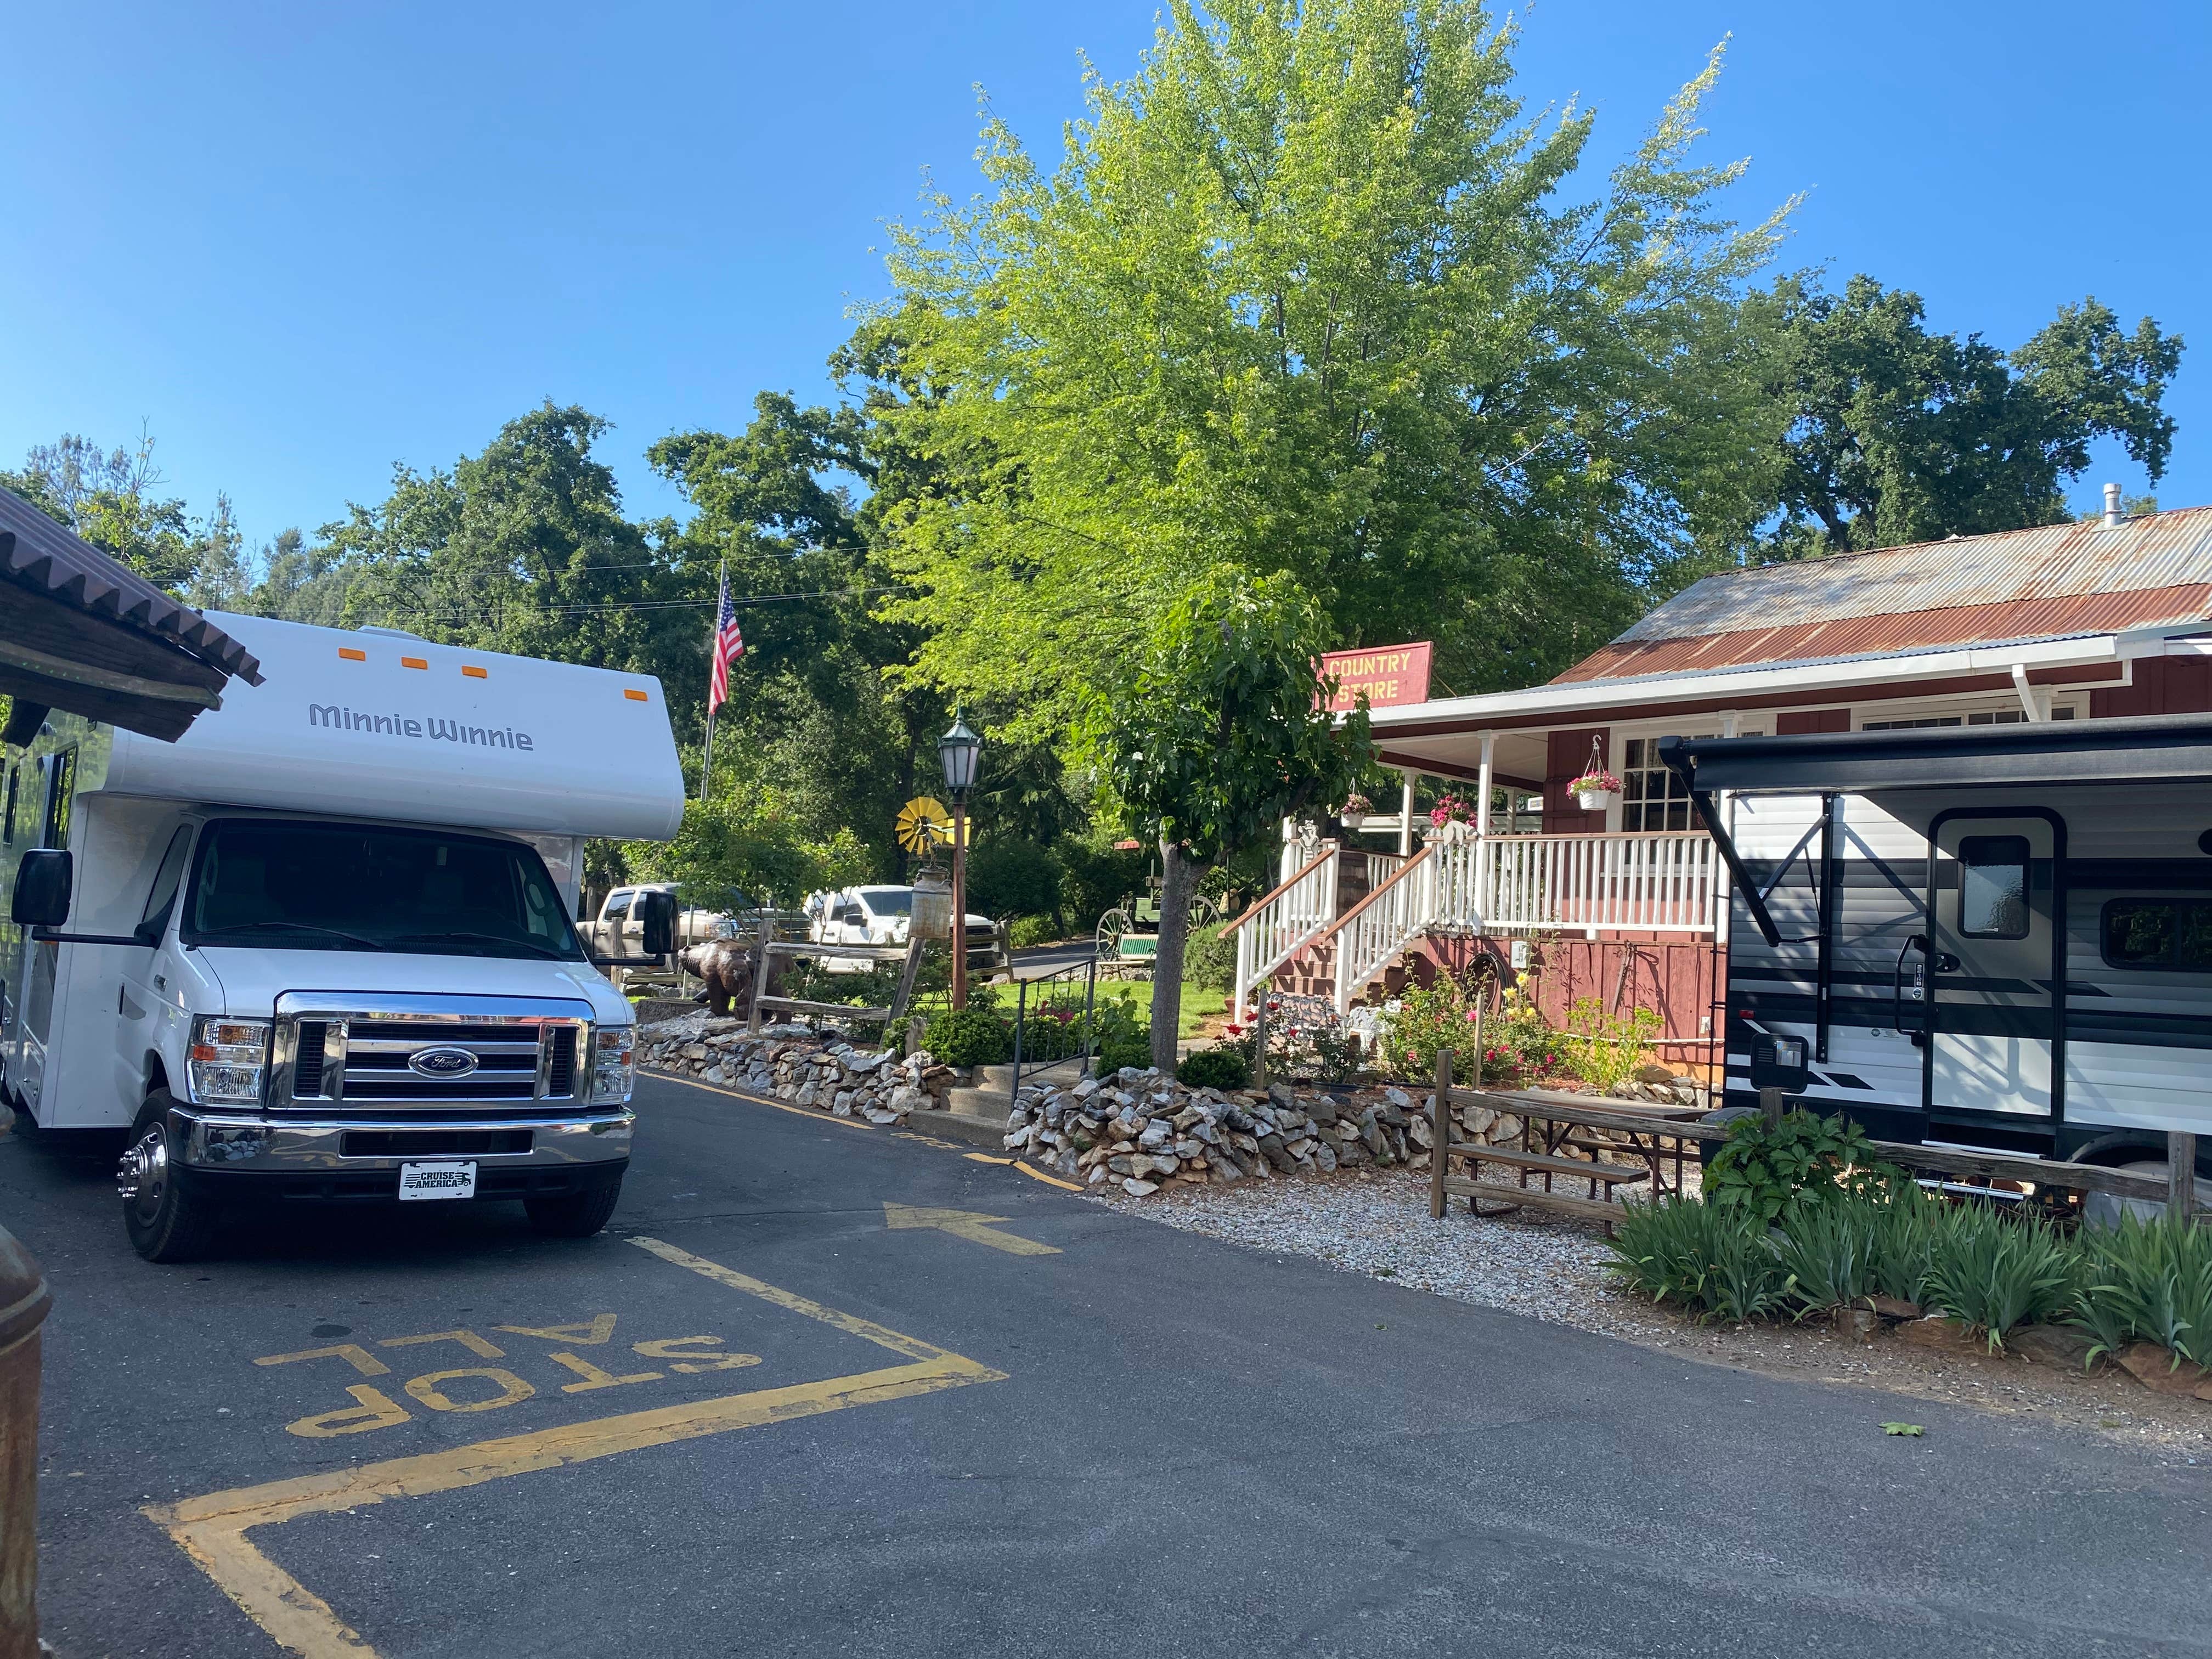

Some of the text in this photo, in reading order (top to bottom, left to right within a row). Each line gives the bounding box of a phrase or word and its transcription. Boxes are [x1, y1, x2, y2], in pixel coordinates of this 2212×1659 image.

[1329, 652, 1410, 677] COUNTRY
[1338, 680, 1398, 702] STORE
[309, 703, 534, 751] Minnie Winnie
[431, 1056, 461, 1068] Ford
[416, 1180, 458, 1188] AMERICA
[420, 1172, 455, 1180] CRUISE
[255, 1313, 617, 1376] ALL
[286, 1335, 763, 1438] STOP
